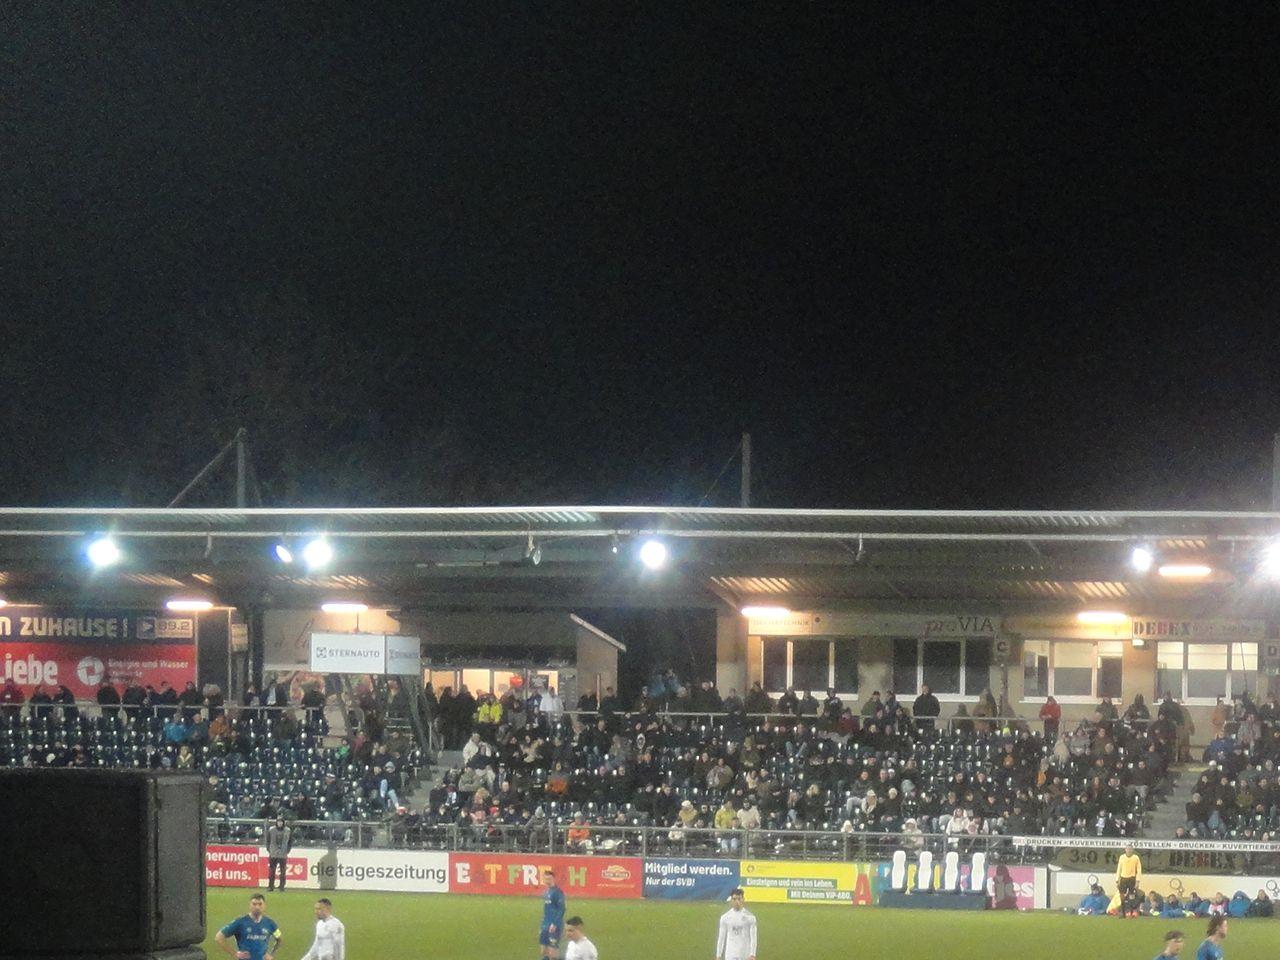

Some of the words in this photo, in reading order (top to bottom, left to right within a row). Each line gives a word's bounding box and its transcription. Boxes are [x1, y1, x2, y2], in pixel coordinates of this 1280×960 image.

[1133, 621, 1193, 636] DEBEX
[329, 649, 380, 659] STERNAUTO
[0, 653, 58, 686] iebe
[1179, 841, 1215, 849] DRUCKEN
[206, 869, 222, 880] bei
[225, 869, 251, 880] uns.
[311, 861, 335, 877] die
[338, 863, 447, 884] tageszeitung
[645, 862, 687, 876] Mitglied
[689, 864, 733, 876] werden.
[646, 877, 659, 886] Nur
[661, 878, 675, 886] der
